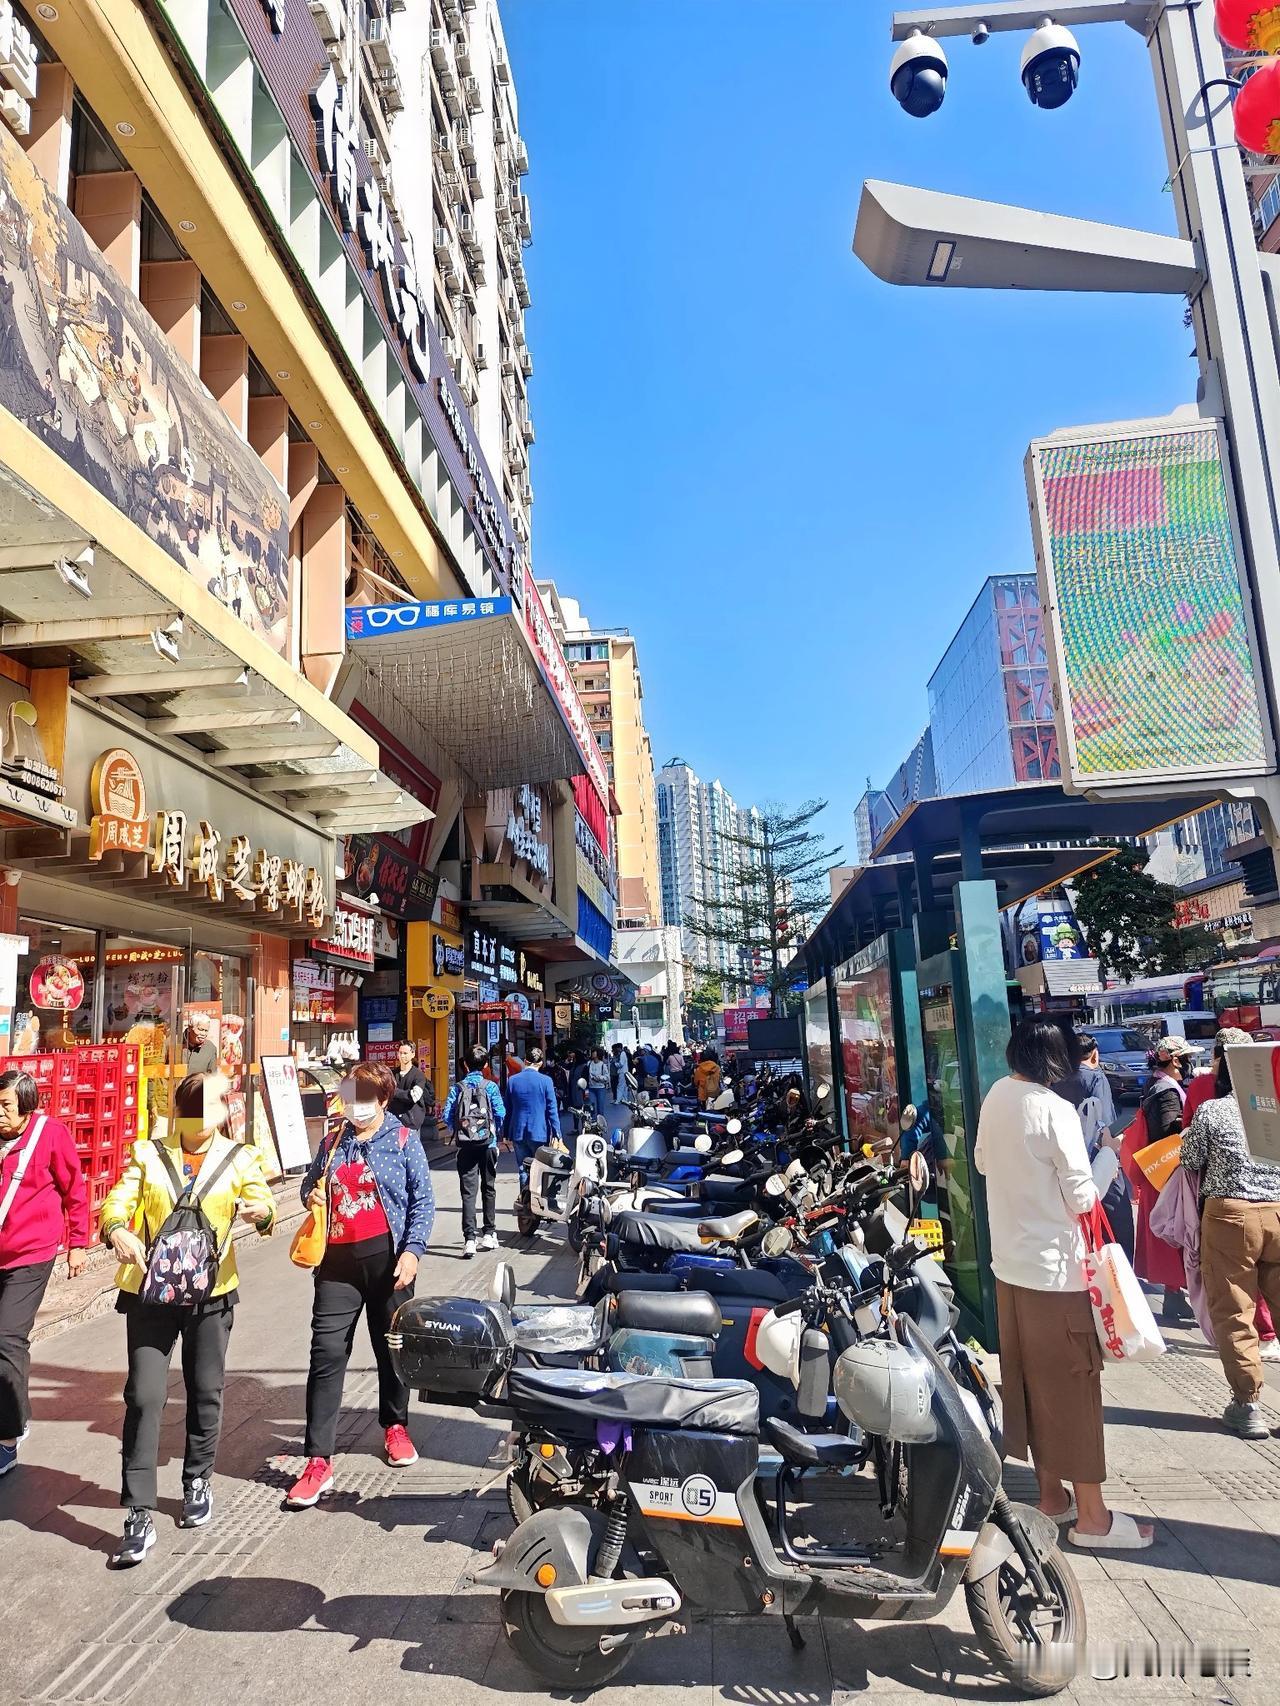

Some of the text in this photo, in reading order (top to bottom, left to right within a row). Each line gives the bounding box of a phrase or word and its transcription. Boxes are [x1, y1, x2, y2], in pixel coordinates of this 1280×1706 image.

[733, 1011, 759, 1025] 招商
[368, 1052, 400, 1061] 福库易
[649, 1490, 674, 1502] SPORT
